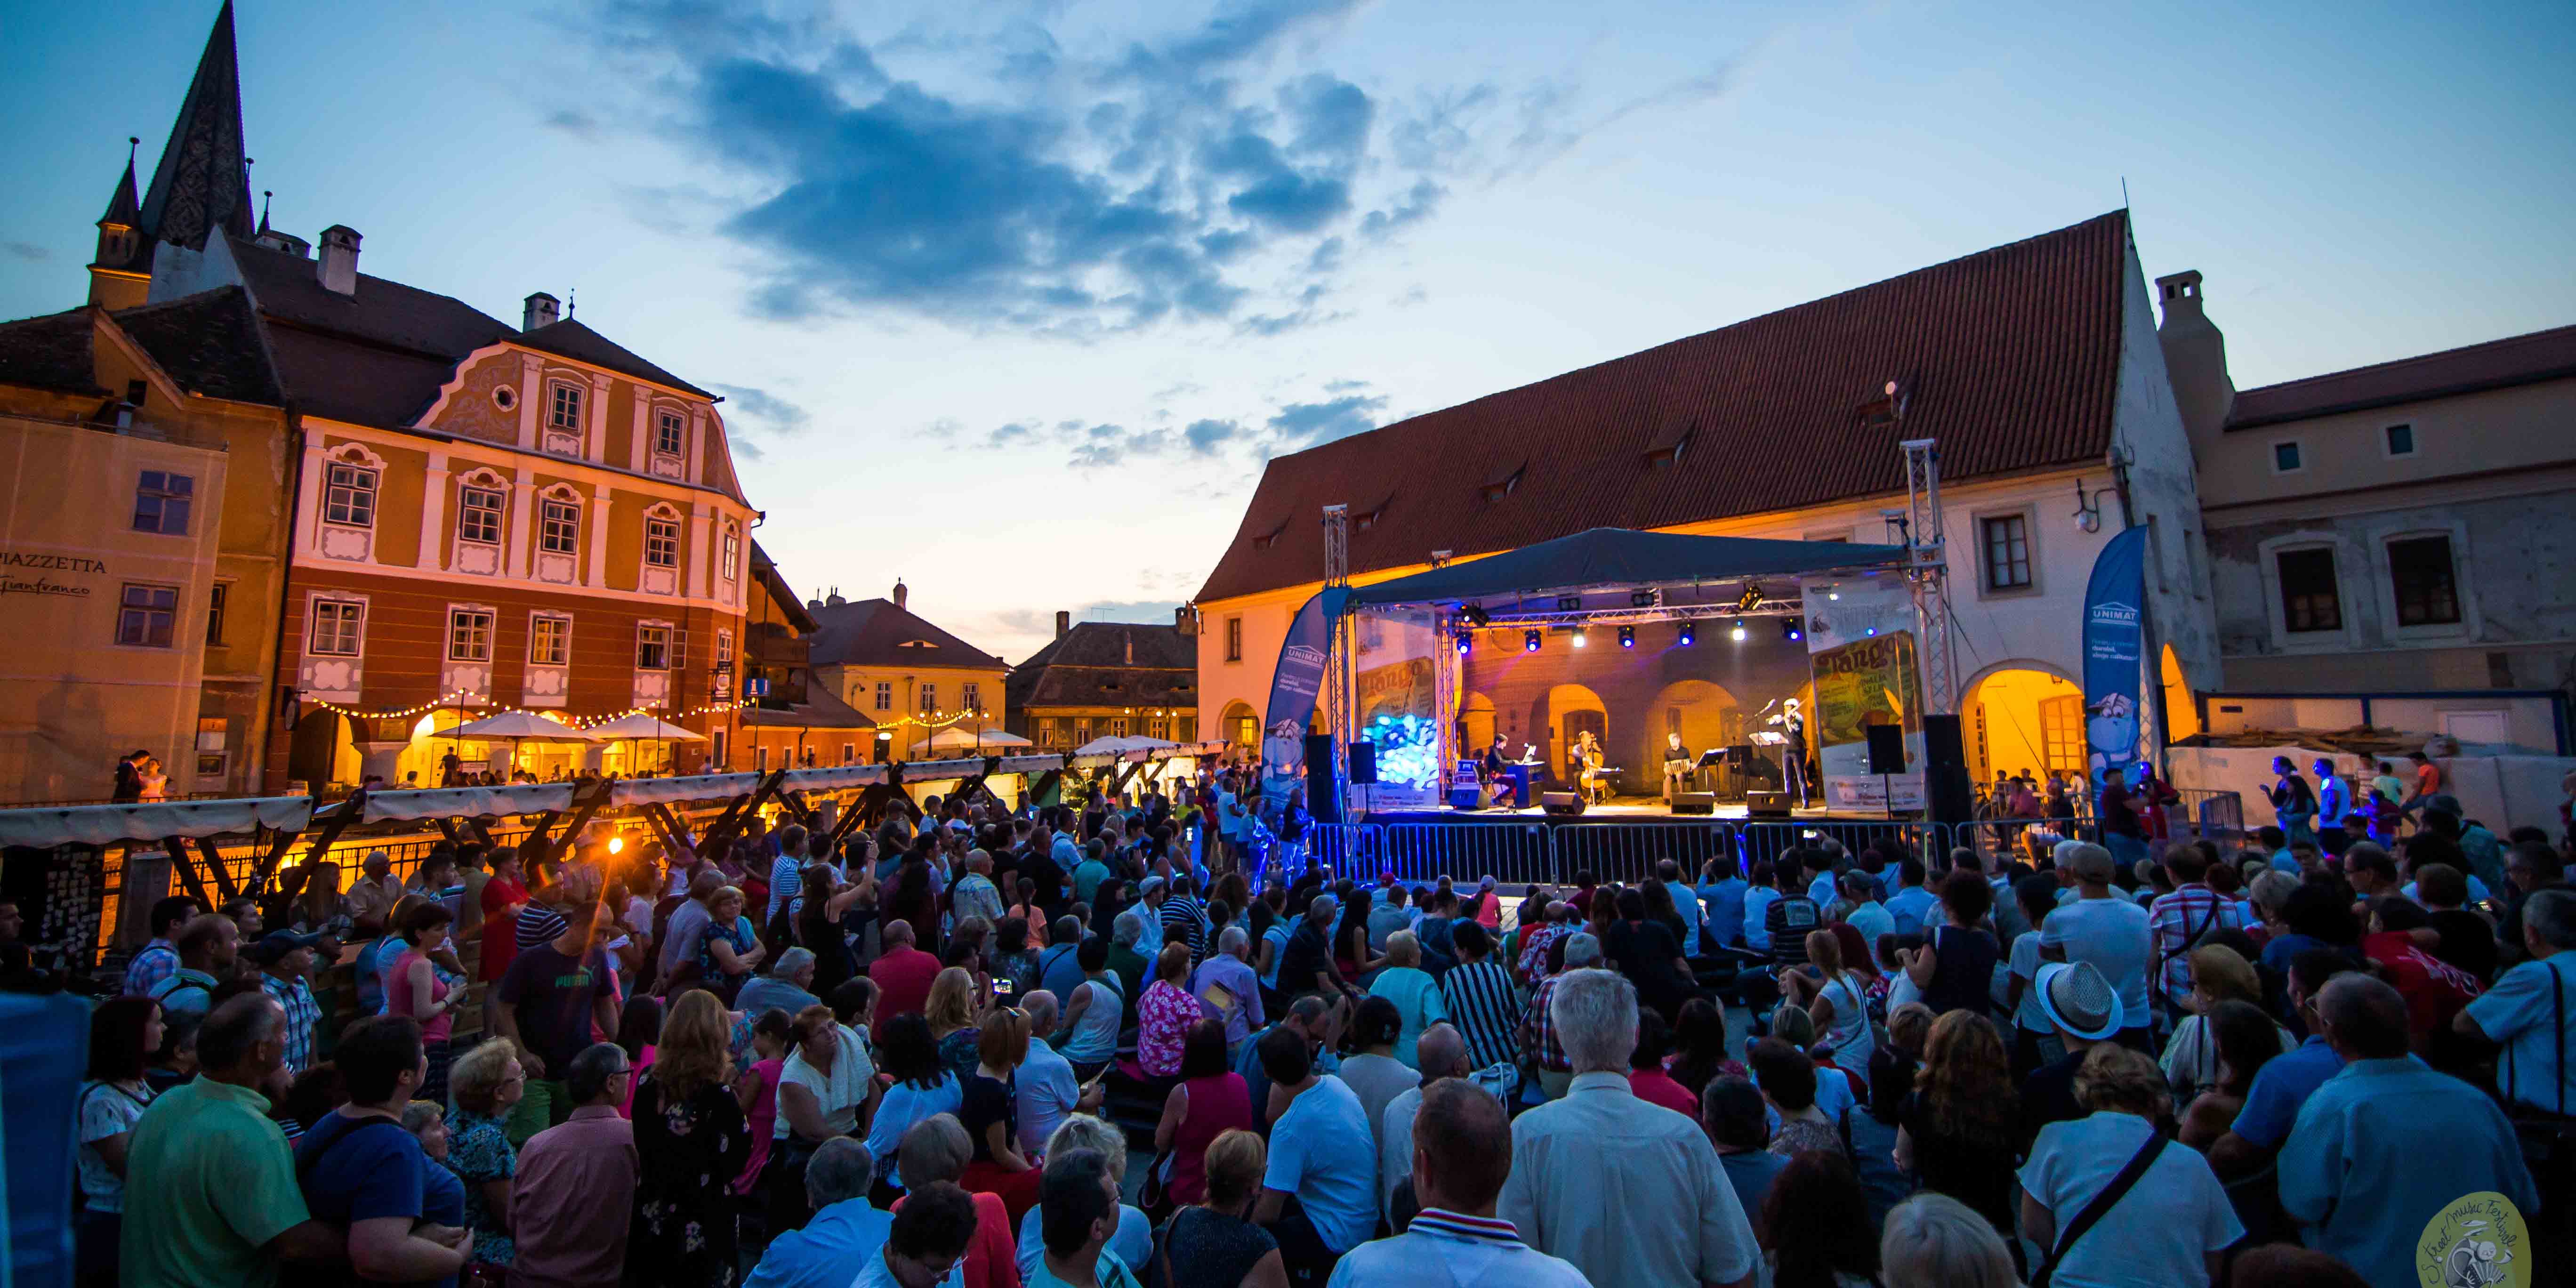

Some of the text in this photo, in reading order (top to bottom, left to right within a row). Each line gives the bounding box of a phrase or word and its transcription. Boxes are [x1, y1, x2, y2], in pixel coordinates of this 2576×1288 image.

[0, 551, 107, 573] IAZZETTA
[2093, 610, 2136, 621] UNIMAT
[1288, 650, 1324, 664] UNIMAT
[1816, 637, 1900, 672] Tango
[1360, 661, 1422, 692] Tango
